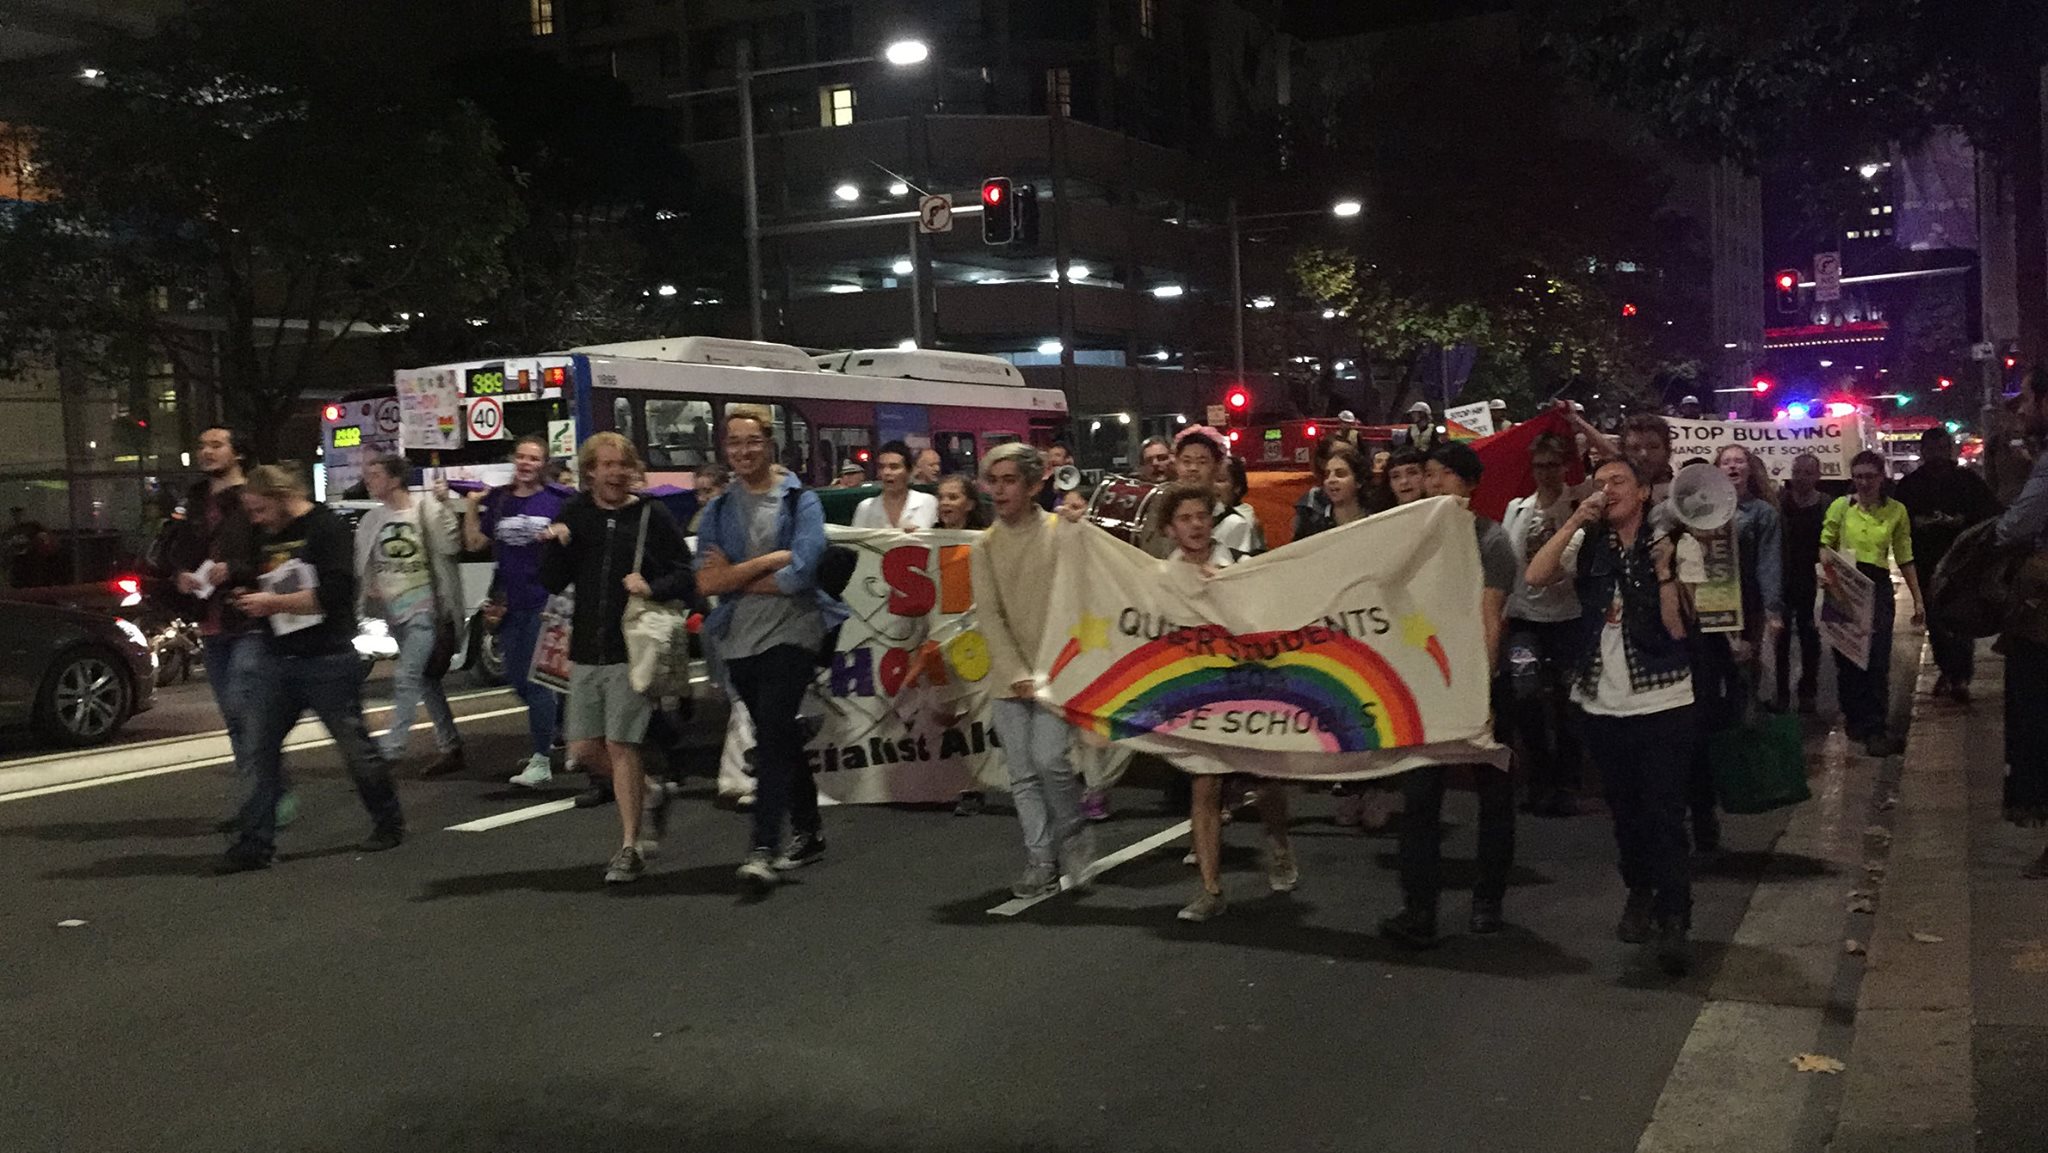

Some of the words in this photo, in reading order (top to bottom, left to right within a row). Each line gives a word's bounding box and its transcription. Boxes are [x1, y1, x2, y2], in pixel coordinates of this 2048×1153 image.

[472, 371, 504, 394] 389
[474, 407, 497, 428] 40
[1668, 425, 1724, 441] STOP
[1733, 424, 1842, 442] BULLYING
[1752, 446, 1776, 456] AFE
[1781, 445, 1842, 455] SCHOOLS
[1119, 606, 1217, 657] QUEER
